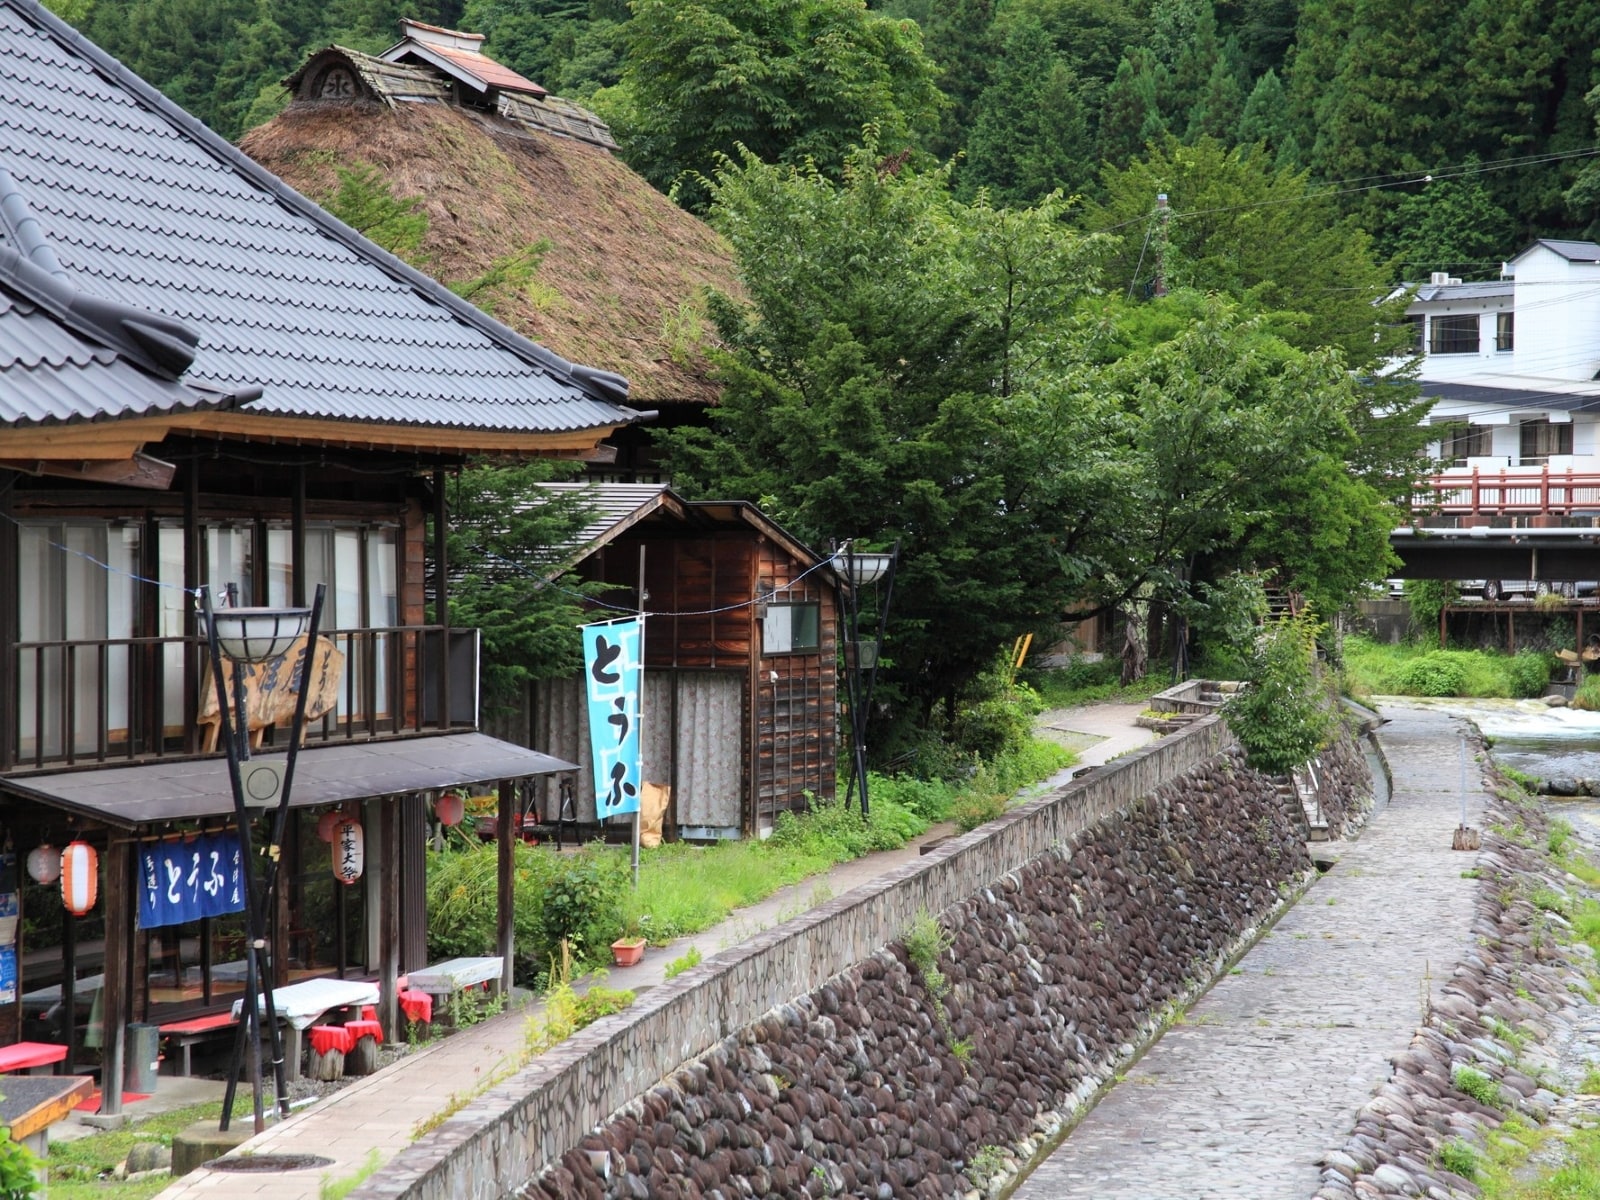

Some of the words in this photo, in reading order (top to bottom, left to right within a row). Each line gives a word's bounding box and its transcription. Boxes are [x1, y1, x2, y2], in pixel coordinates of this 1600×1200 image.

[592, 634, 636, 807] とうふ
[164, 851, 225, 904] とうふ
[340, 823, 358, 879] 平家大祭
